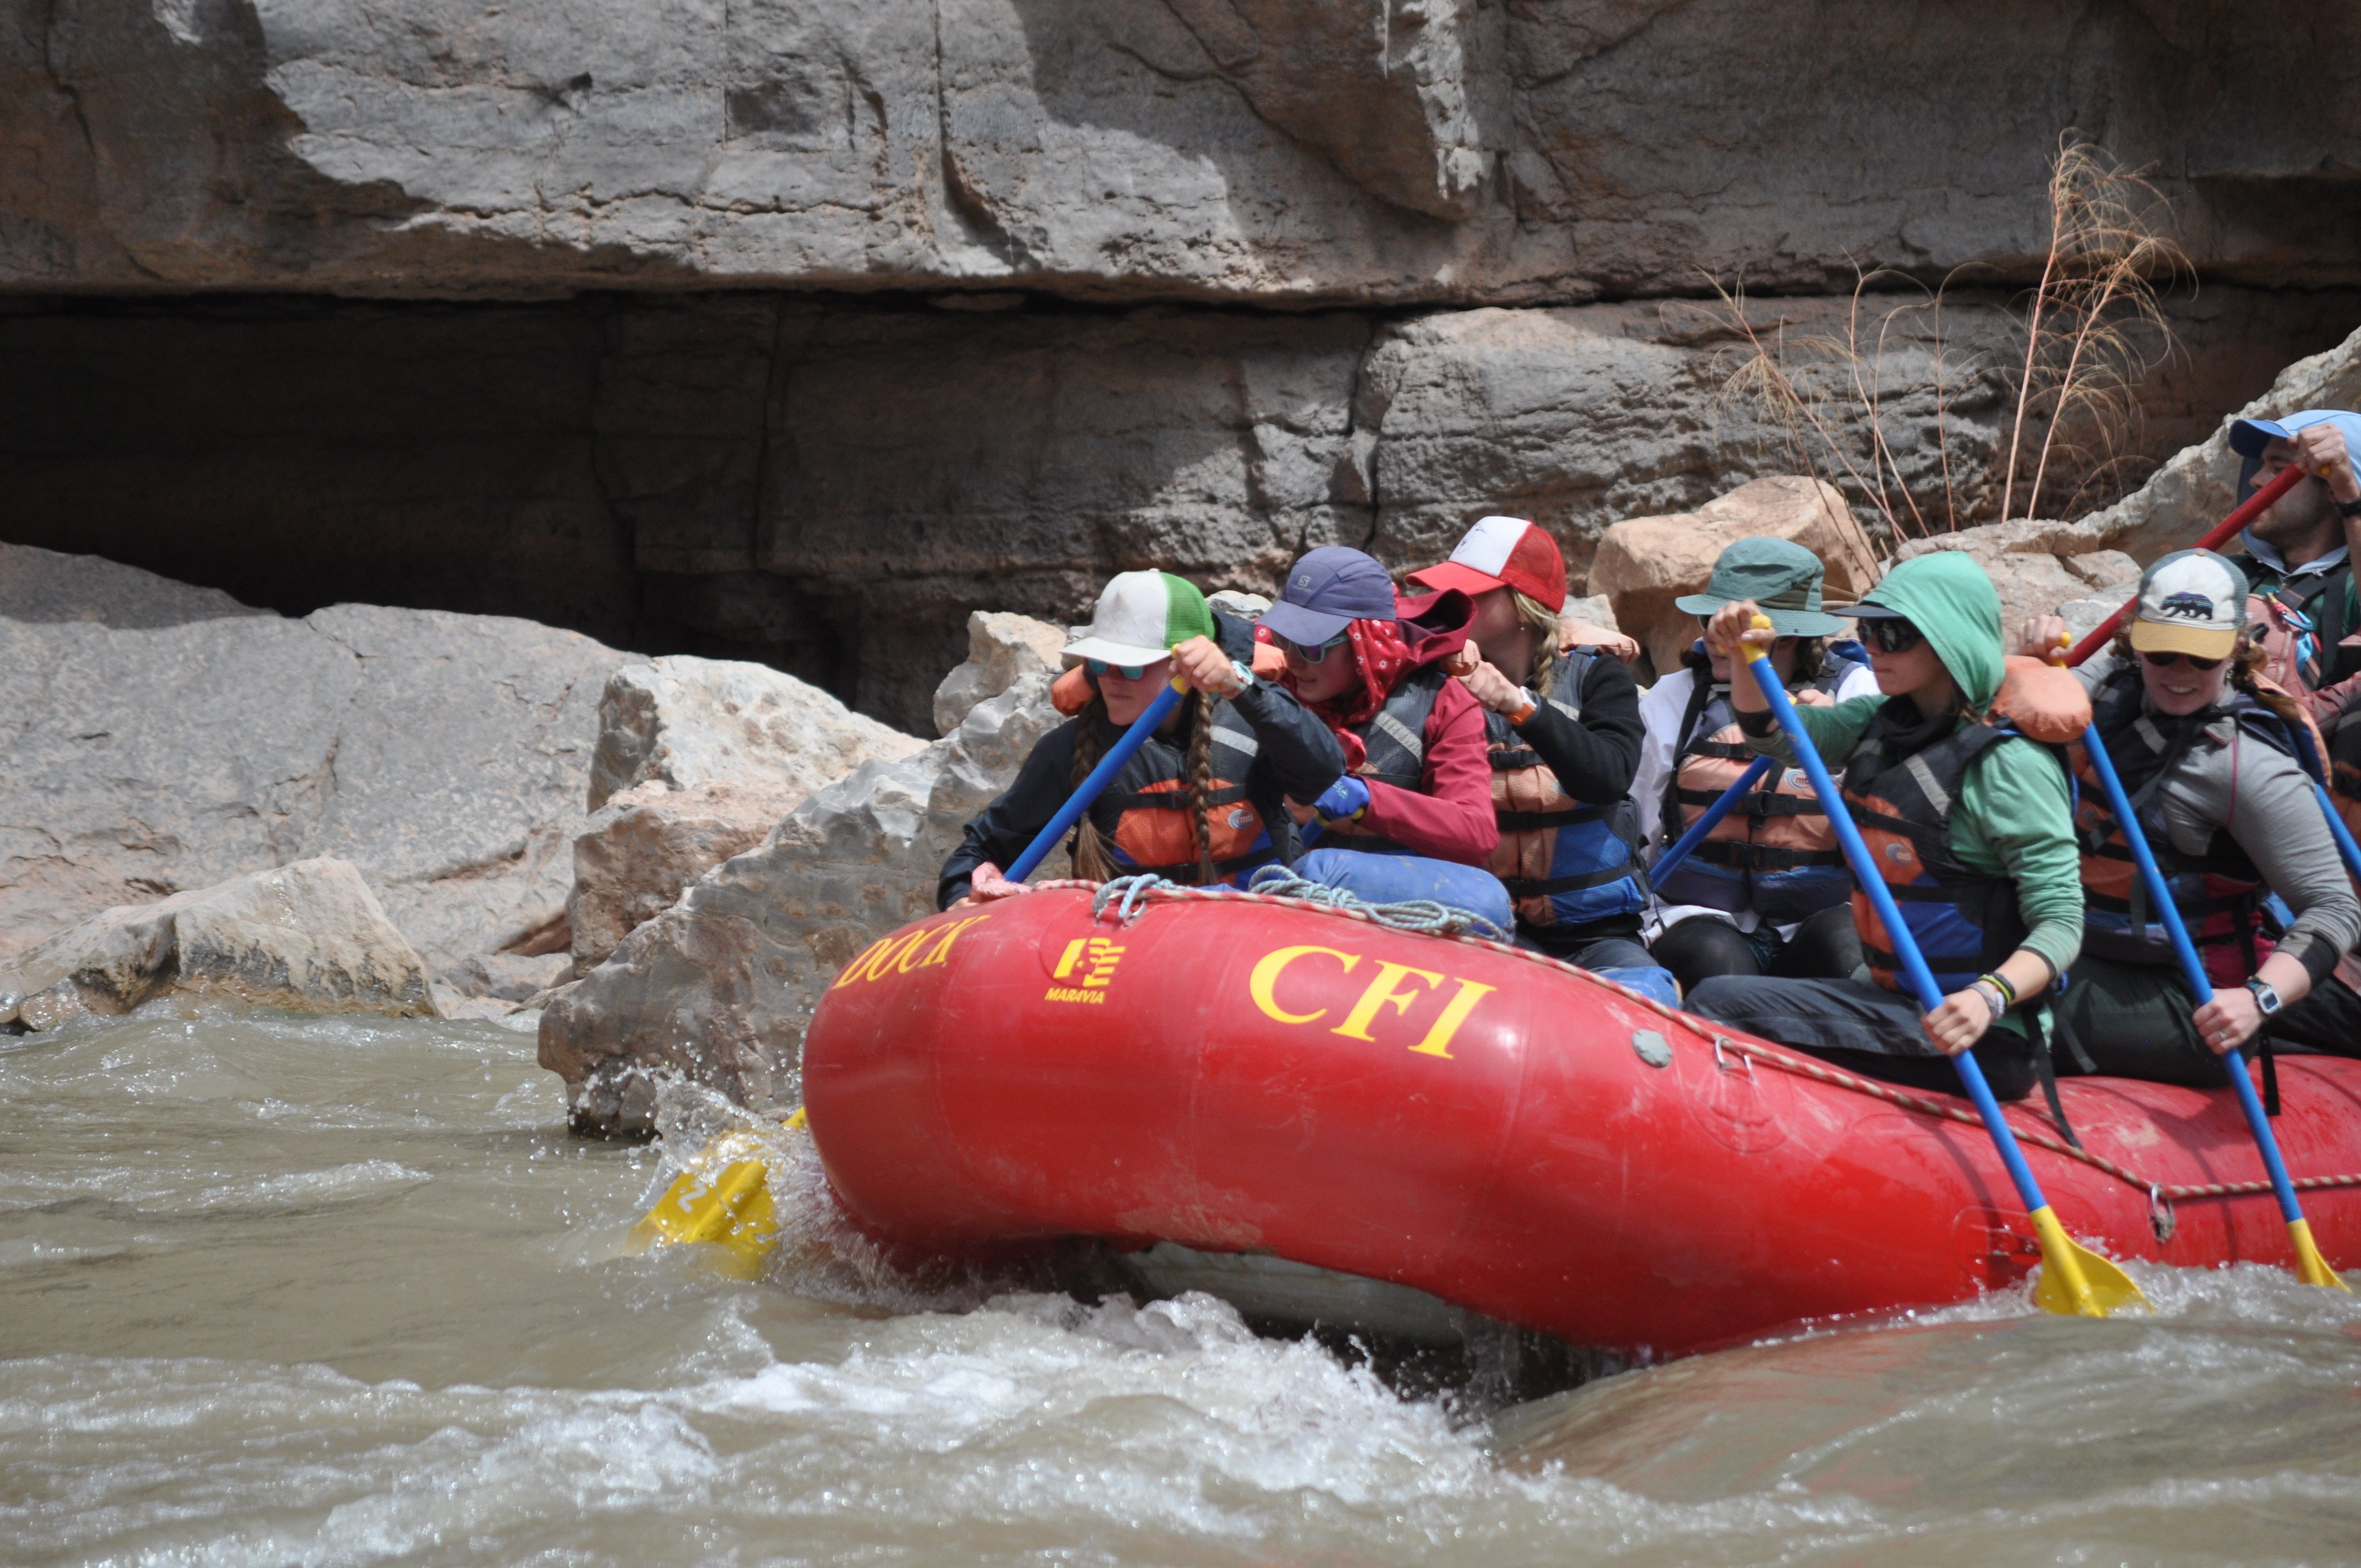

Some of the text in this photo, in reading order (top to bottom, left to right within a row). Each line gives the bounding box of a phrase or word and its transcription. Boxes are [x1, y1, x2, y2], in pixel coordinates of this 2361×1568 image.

[831, 915, 991, 989] DOCK
[1045, 987, 1105, 1004] MARAVIA
[1249, 945, 1497, 1059] CFI
